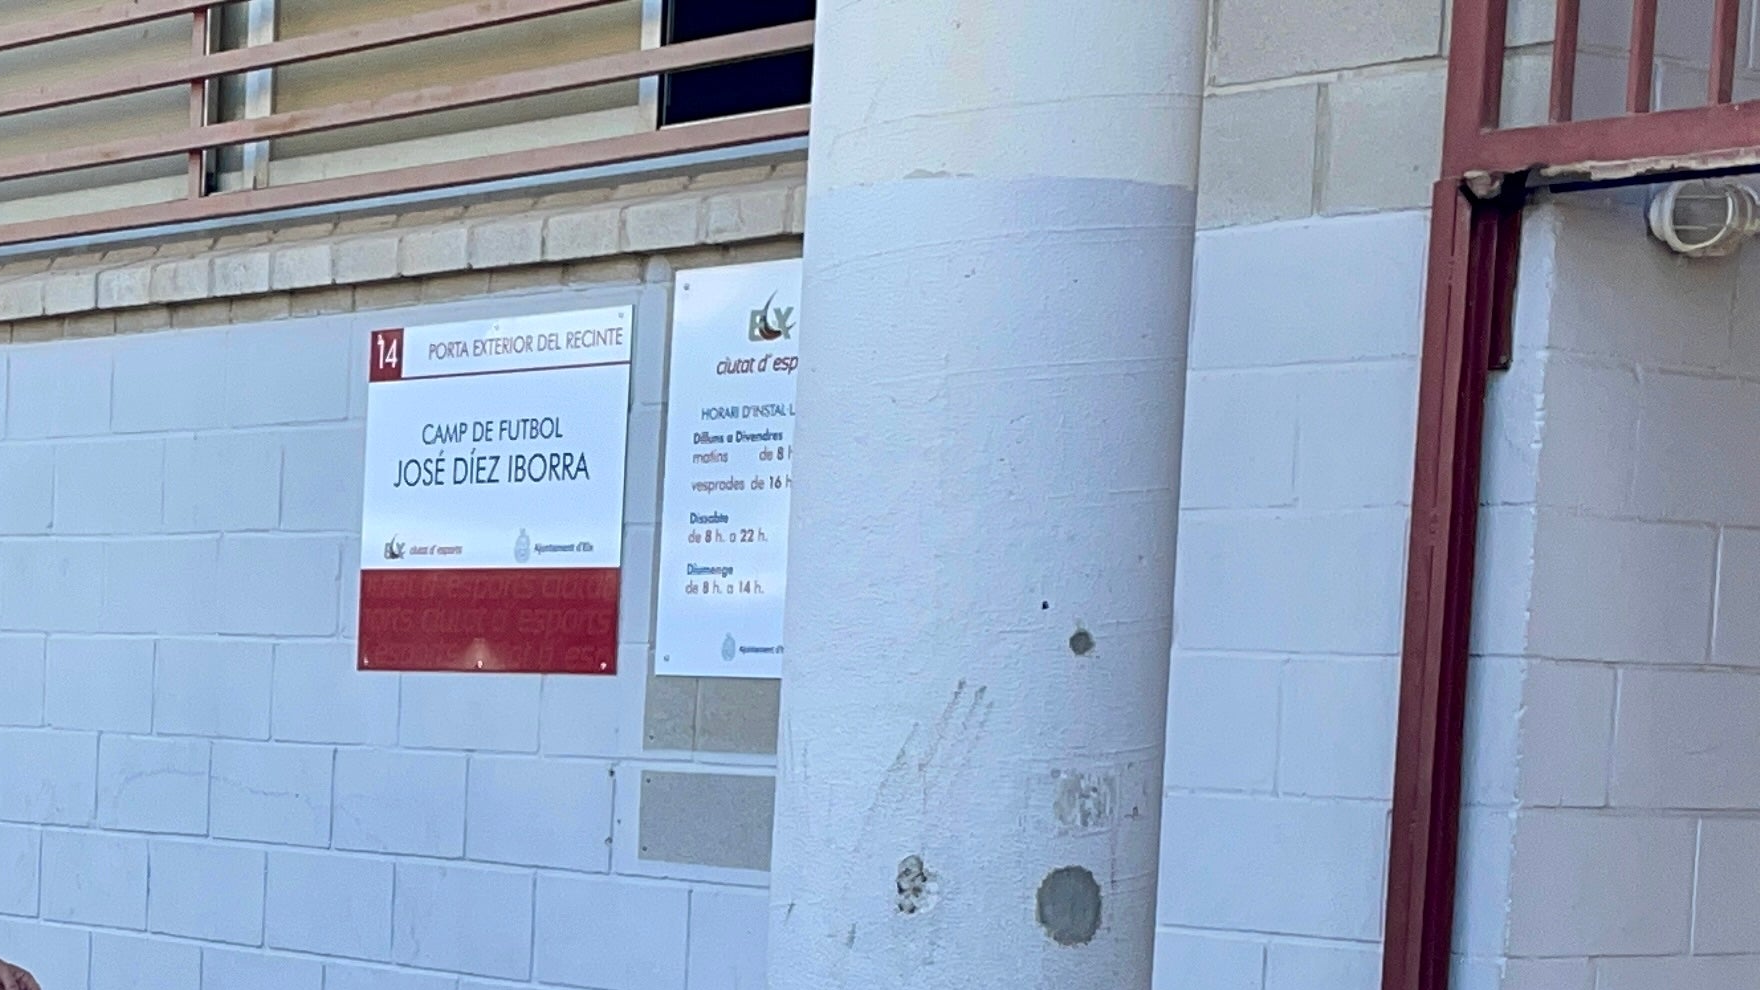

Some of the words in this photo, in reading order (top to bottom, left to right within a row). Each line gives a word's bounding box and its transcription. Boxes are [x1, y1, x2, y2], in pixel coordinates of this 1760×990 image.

[377, 334, 398, 369] 14
[429, 341, 469, 360] PORTA
[473, 335, 533, 357] EXTERIOR
[538, 333, 562, 352] DEL
[566, 327, 623, 349] RECINTE
[716, 356, 755, 375] ciutat
[701, 406, 739, 420] HORARI
[422, 422, 468, 445] CAMP
[473, 420, 493, 442] DE
[499, 416, 563, 440] FUTBOL
[693, 431, 724, 445] Dilluns
[726, 434, 733, 443] a
[736, 427, 783, 443] Divendres
[693, 449, 728, 464] matins
[759, 445, 773, 461] de
[777, 446, 784, 461] 8
[393, 451, 444, 488] JOSÉ
[453, 448, 500, 484] DÍEZ
[508, 452, 590, 483] IBORRA
[691, 475, 745, 495] vesprades
[751, 474, 765, 490] de
[770, 475, 782, 489] 16
[690, 511, 729, 524] Dissabte
[688, 529, 701, 543] de
[705, 530, 712, 543] 8
[730, 532, 736, 542] a
[740, 529, 754, 542] 22
[758, 528, 768, 542] h.
[685, 580, 699, 594] de
[702, 581, 709, 594] 8
[727, 584, 733, 594] a
[739, 580, 751, 594] 14
[754, 579, 764, 594] h.
